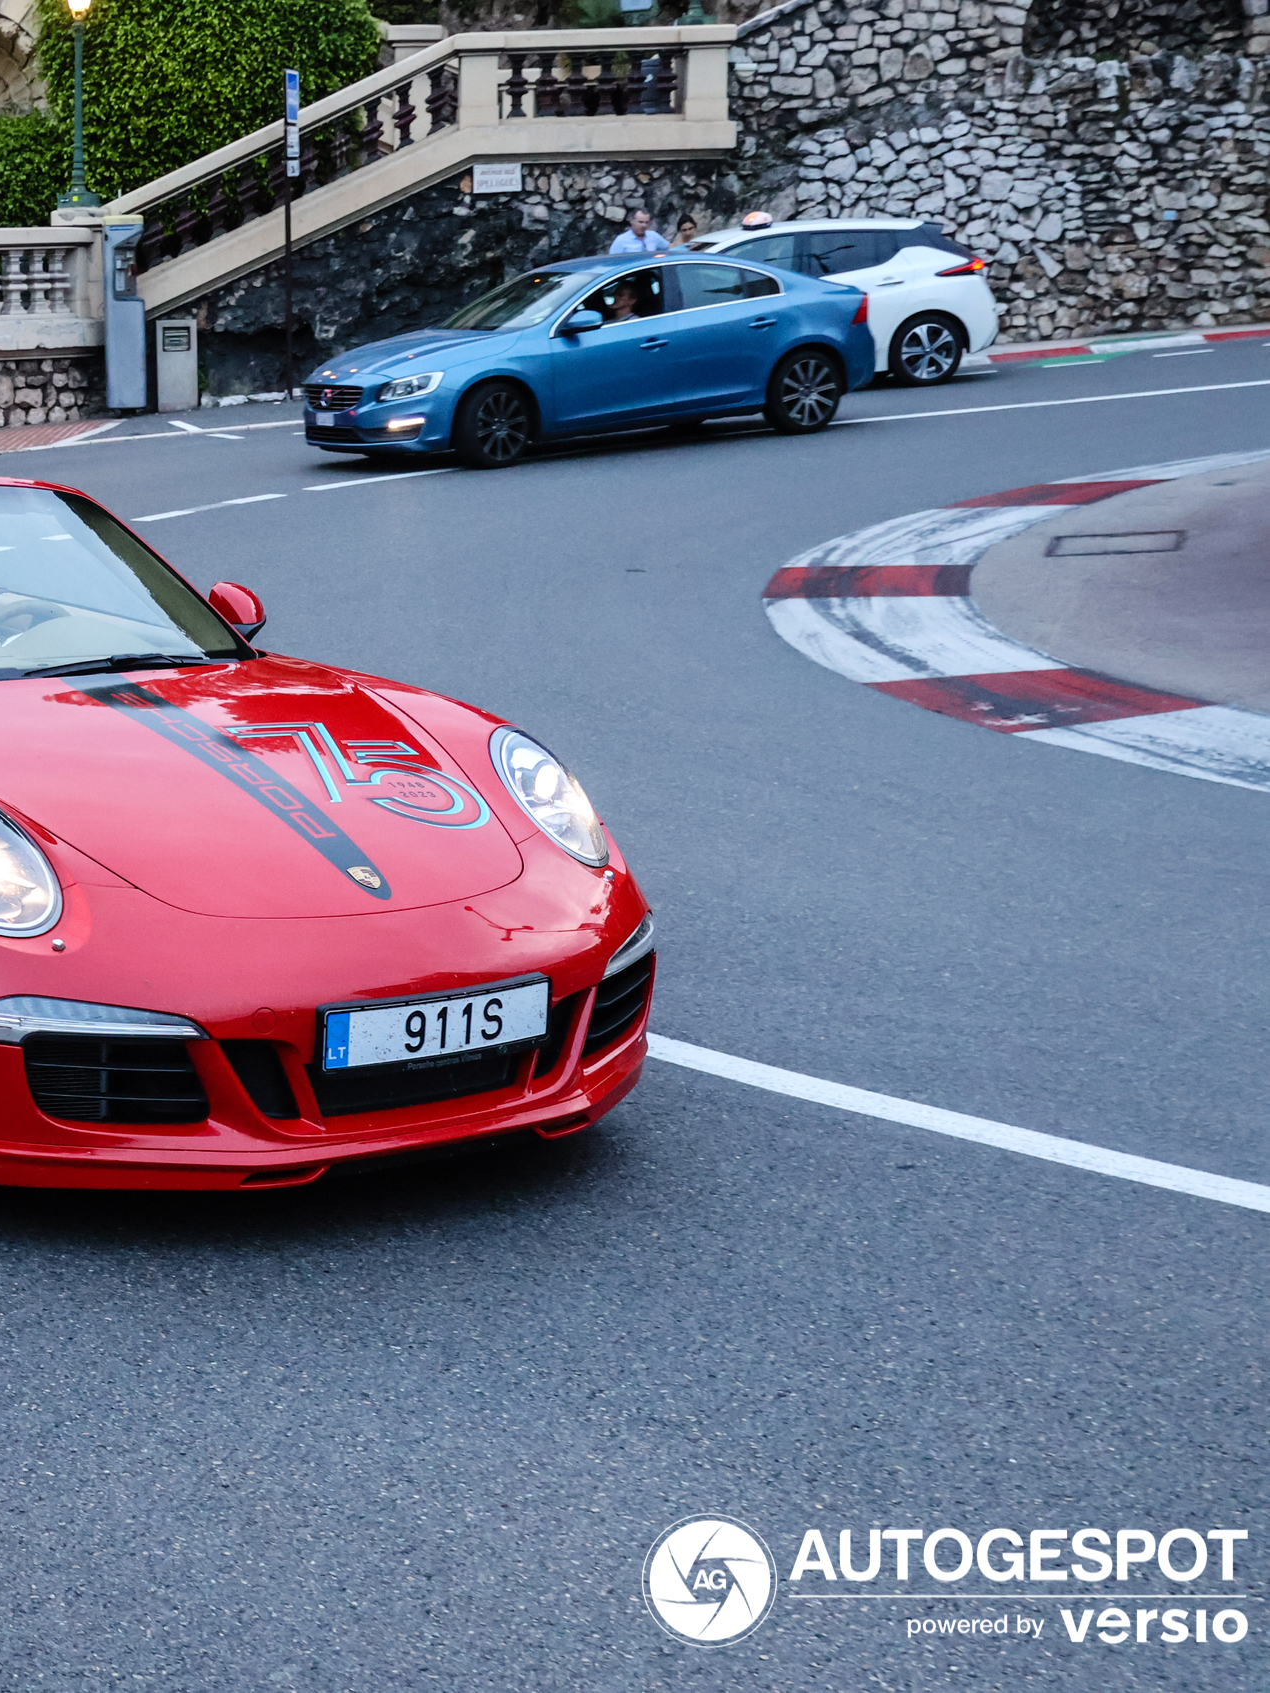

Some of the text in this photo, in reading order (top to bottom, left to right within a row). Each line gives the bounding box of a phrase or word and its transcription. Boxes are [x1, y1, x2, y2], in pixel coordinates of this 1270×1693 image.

[109, 692, 337, 839] PORSCHE
[214, 721, 491, 830] 75
[387, 781, 426, 789] 1948
[328, 997, 503, 1060] LT 911S
